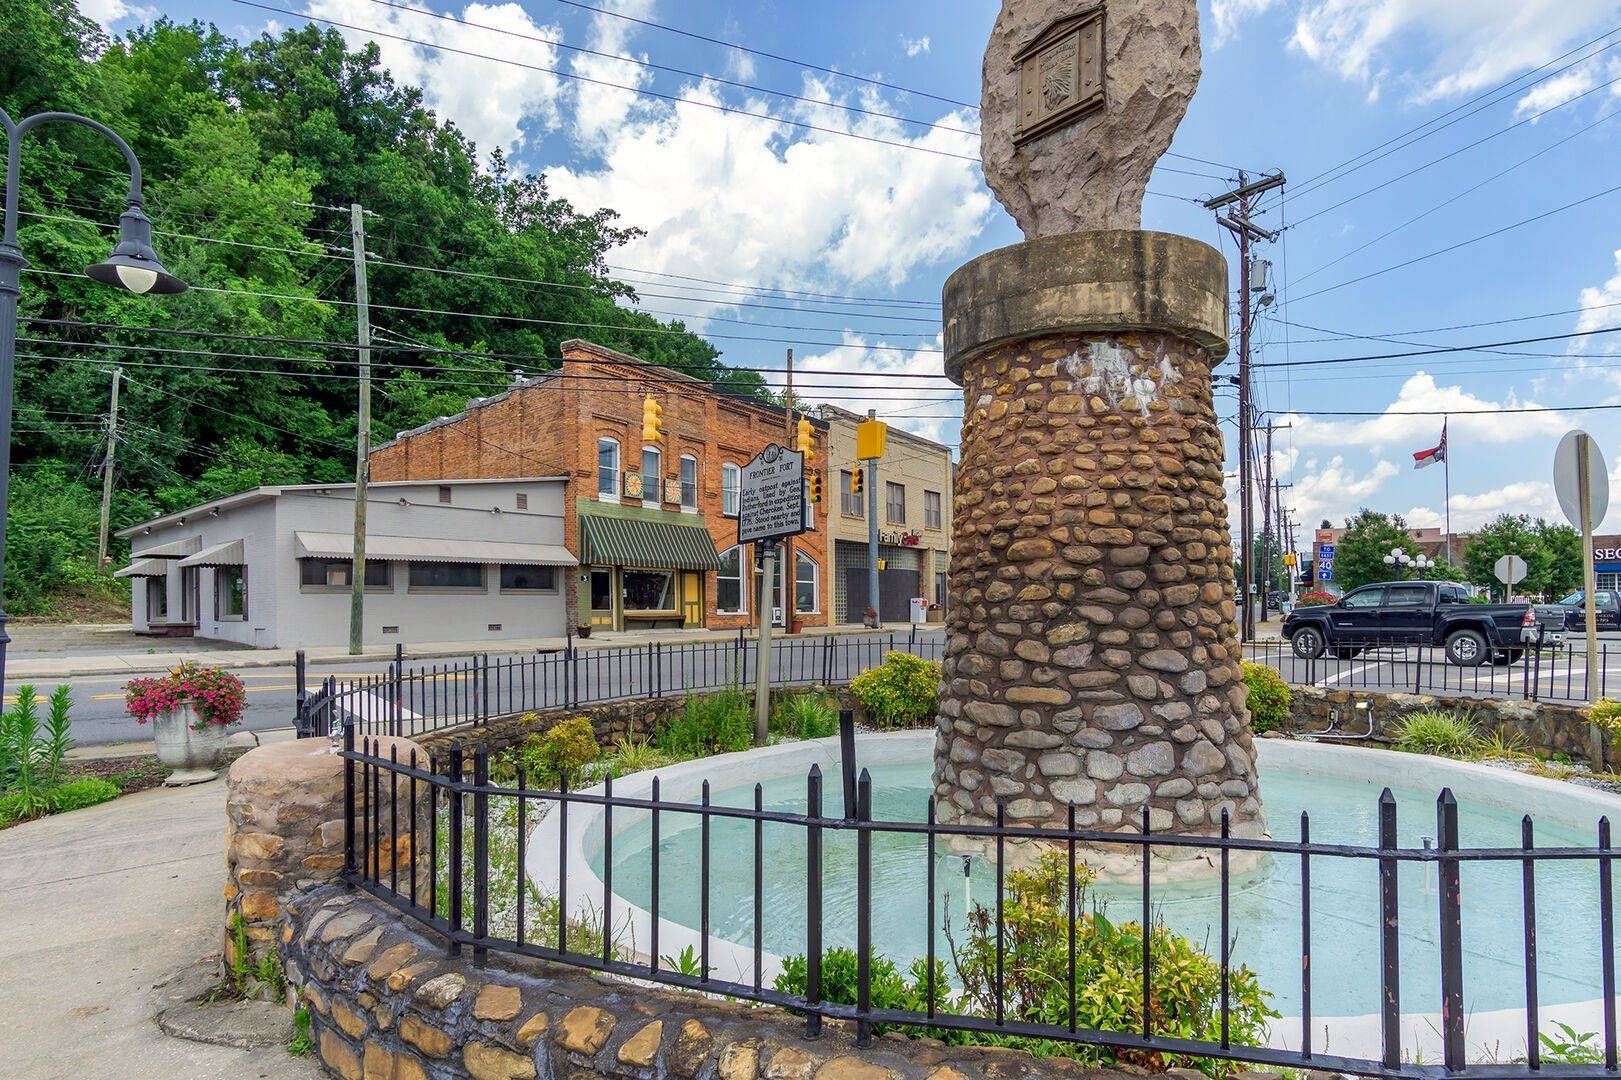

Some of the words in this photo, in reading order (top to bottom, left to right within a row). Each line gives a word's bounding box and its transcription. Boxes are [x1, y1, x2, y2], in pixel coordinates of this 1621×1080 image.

[749, 467, 775, 479] FRONTIER
[779, 462, 794, 473] FORT
[759, 483, 778, 492] outpost
[781, 478, 801, 487] against
[763, 491, 776, 499] Used
[779, 488, 786, 497] by
[774, 494, 801, 505] expedition
[755, 515, 770, 524] Stood
[771, 511, 788, 521] nearby
[753, 523, 765, 532] name
[767, 522, 773, 530] to
[774, 520, 784, 528] this
[1319, 561, 1332, 570] 40
